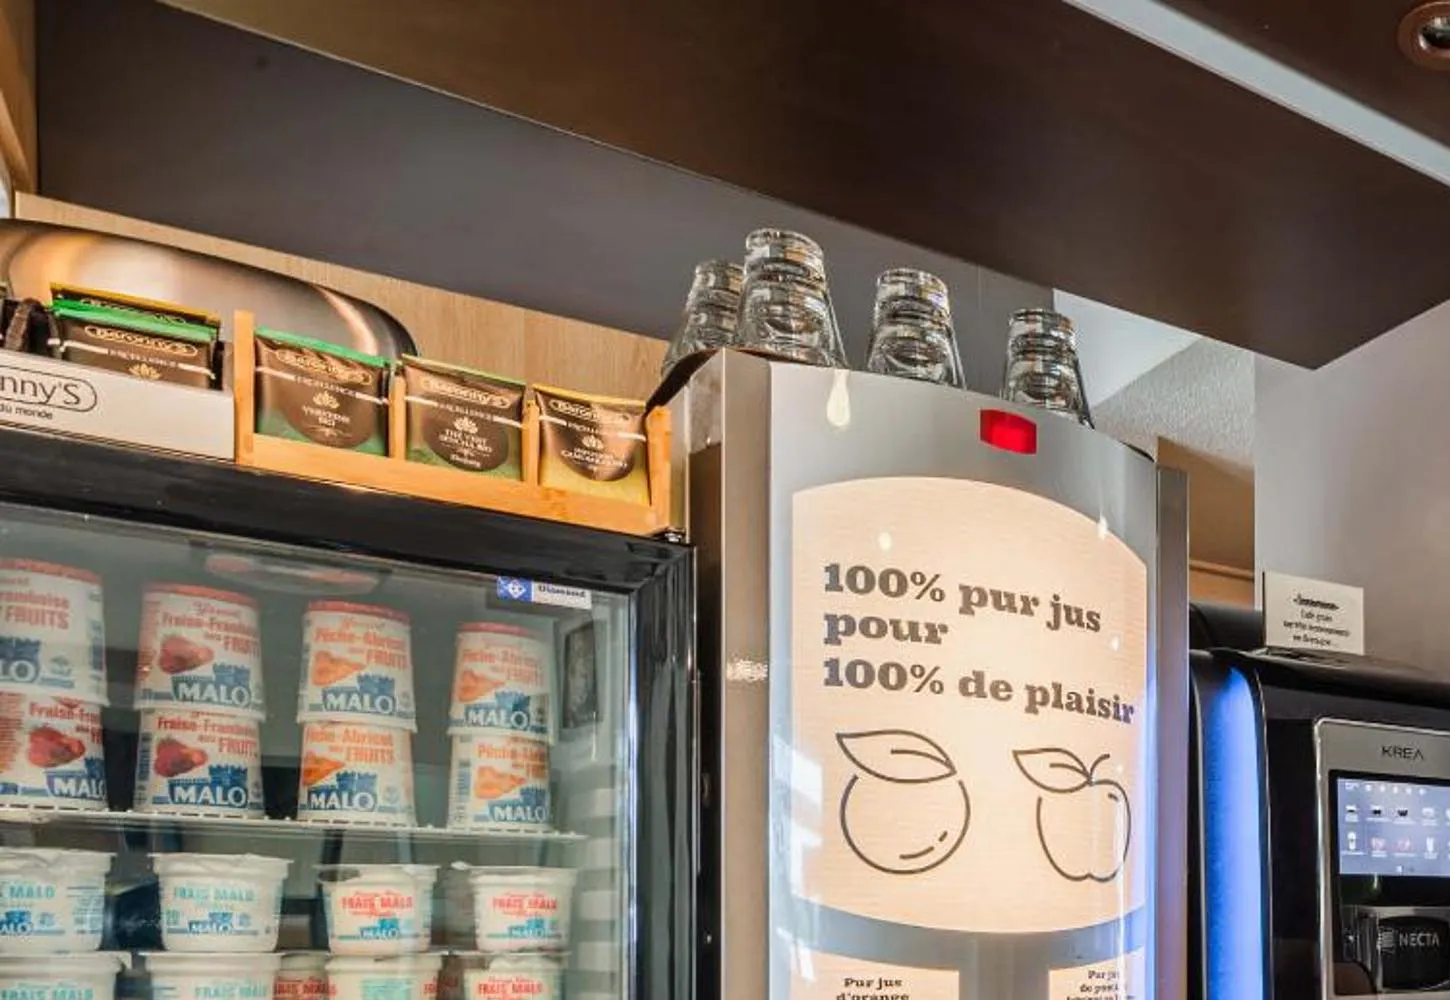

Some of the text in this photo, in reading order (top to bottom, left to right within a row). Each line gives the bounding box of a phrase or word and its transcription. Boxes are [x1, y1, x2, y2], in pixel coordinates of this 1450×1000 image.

[15, 407, 54, 420] monde
[824, 562, 1101, 633] 100% pur jus
[823, 611, 949, 645] pour
[178, 682, 249, 706] MALO
[823, 657, 1135, 725] 100% de plaisir
[326, 692, 394, 713] MALO
[467, 708, 529, 729] MALO
[1381, 745, 1425, 760] KREA
[174, 785, 247, 807] MALO
[310, 791, 375, 812] MALO
[494, 805, 547, 822] MALO
[1400, 932, 1440, 948] NECTA
[843, 976, 903, 990] Pur jus
